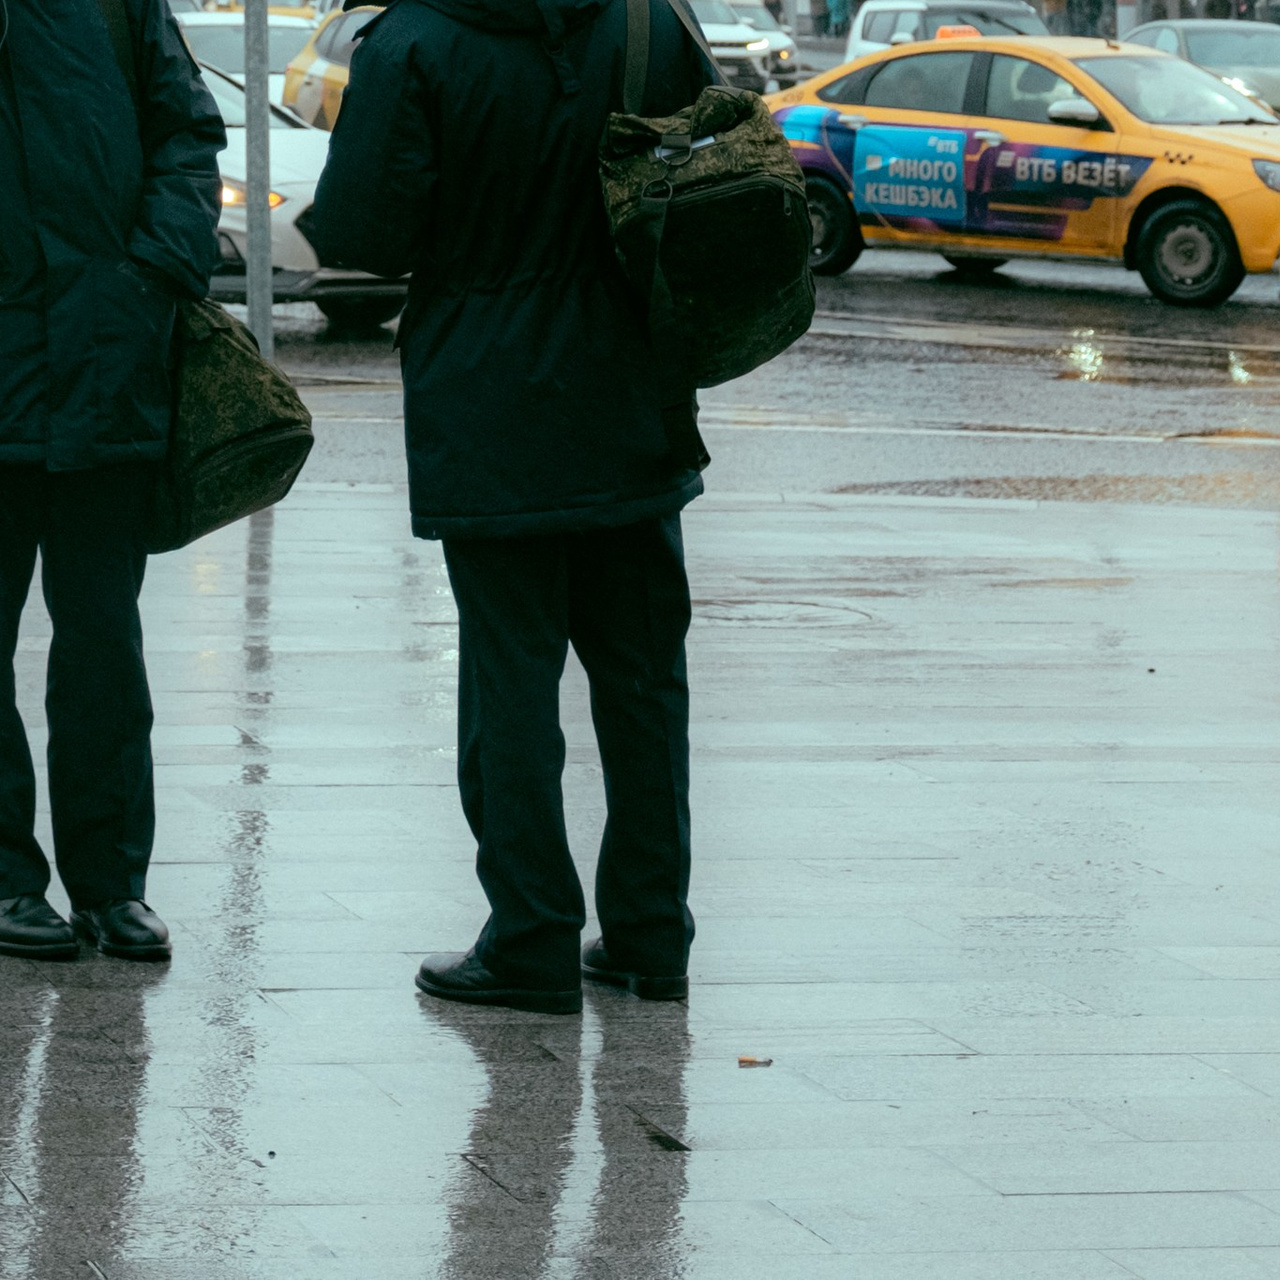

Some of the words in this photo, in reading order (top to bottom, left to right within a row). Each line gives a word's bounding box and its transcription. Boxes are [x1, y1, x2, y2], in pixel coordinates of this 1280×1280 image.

[889, 157, 957, 182] МНОГО
[1015, 156, 1057, 183] ВТБ
[1061, 157, 1131, 187] ВЕЗЁТ
[865, 182, 958, 209] КЕШБЭКА
